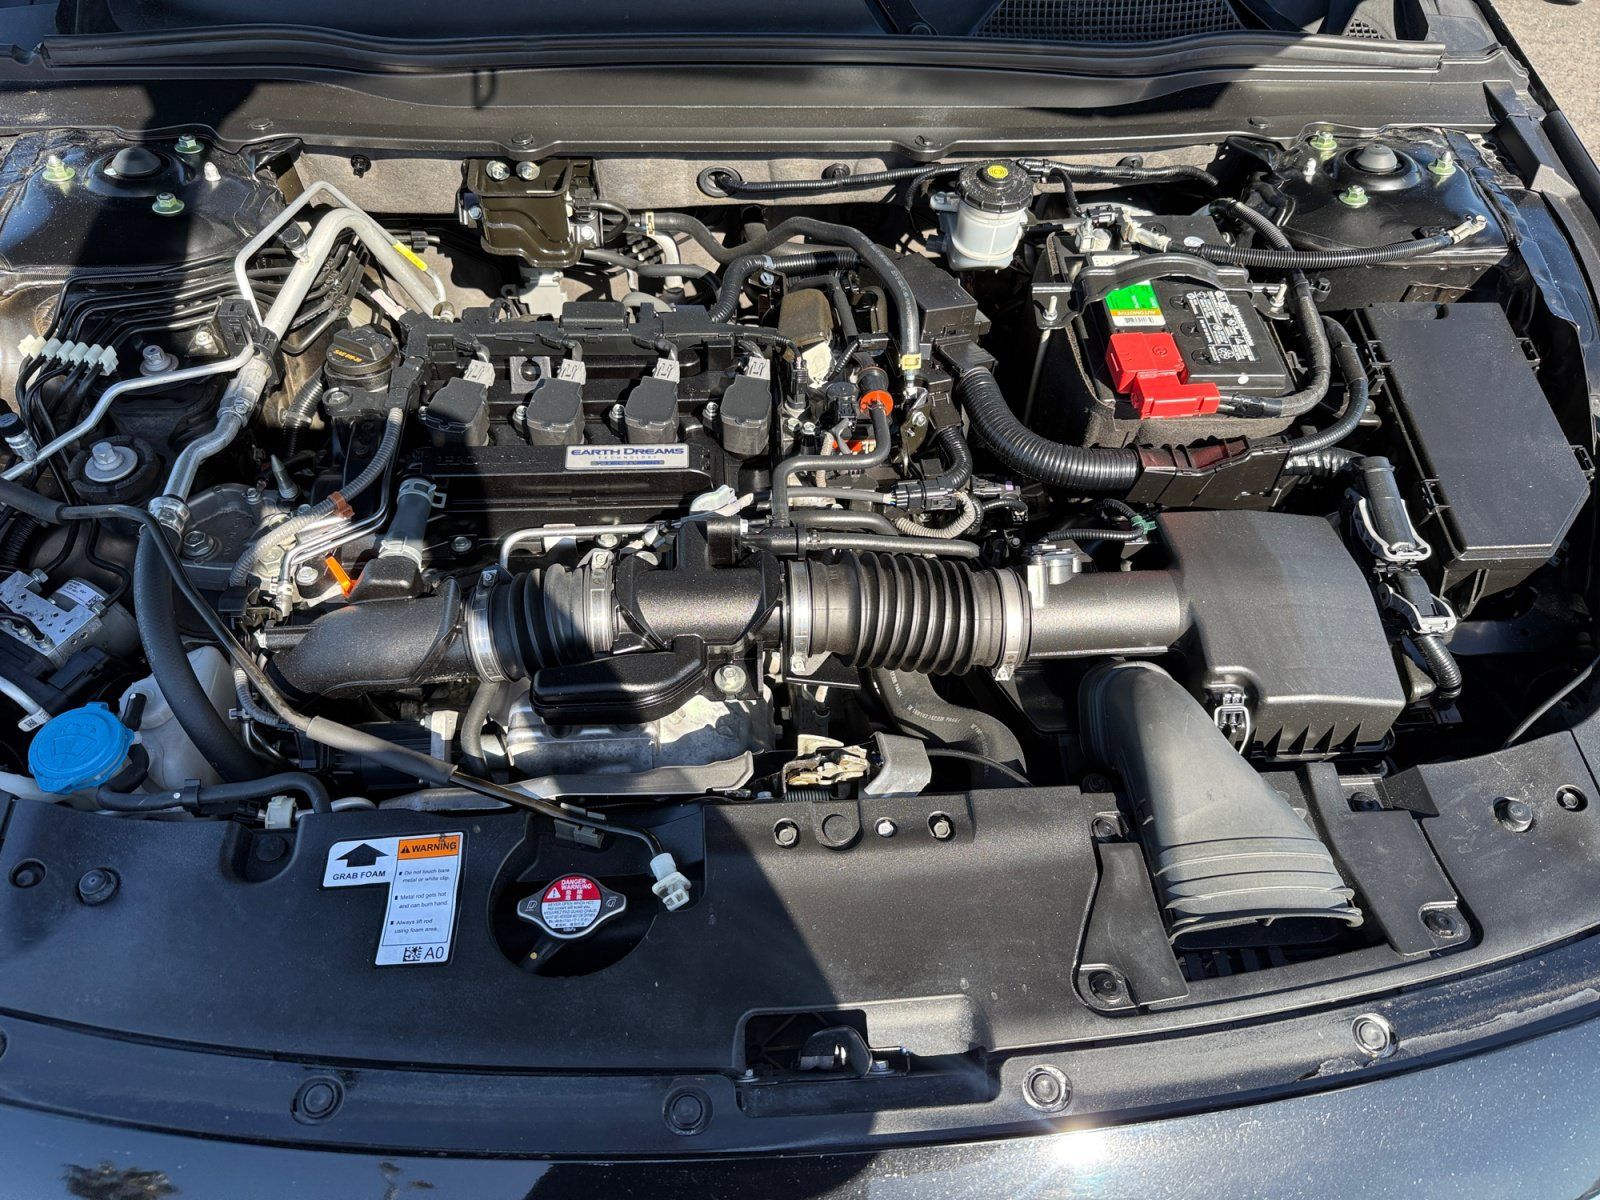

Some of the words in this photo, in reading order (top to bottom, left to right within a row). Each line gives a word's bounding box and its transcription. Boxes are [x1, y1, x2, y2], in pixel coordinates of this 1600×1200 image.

[624, 447, 684, 455] DREAMS
[412, 841, 457, 852] WARNING
[333, 872, 358, 881] GRAB
[361, 870, 386, 878] FOAM
